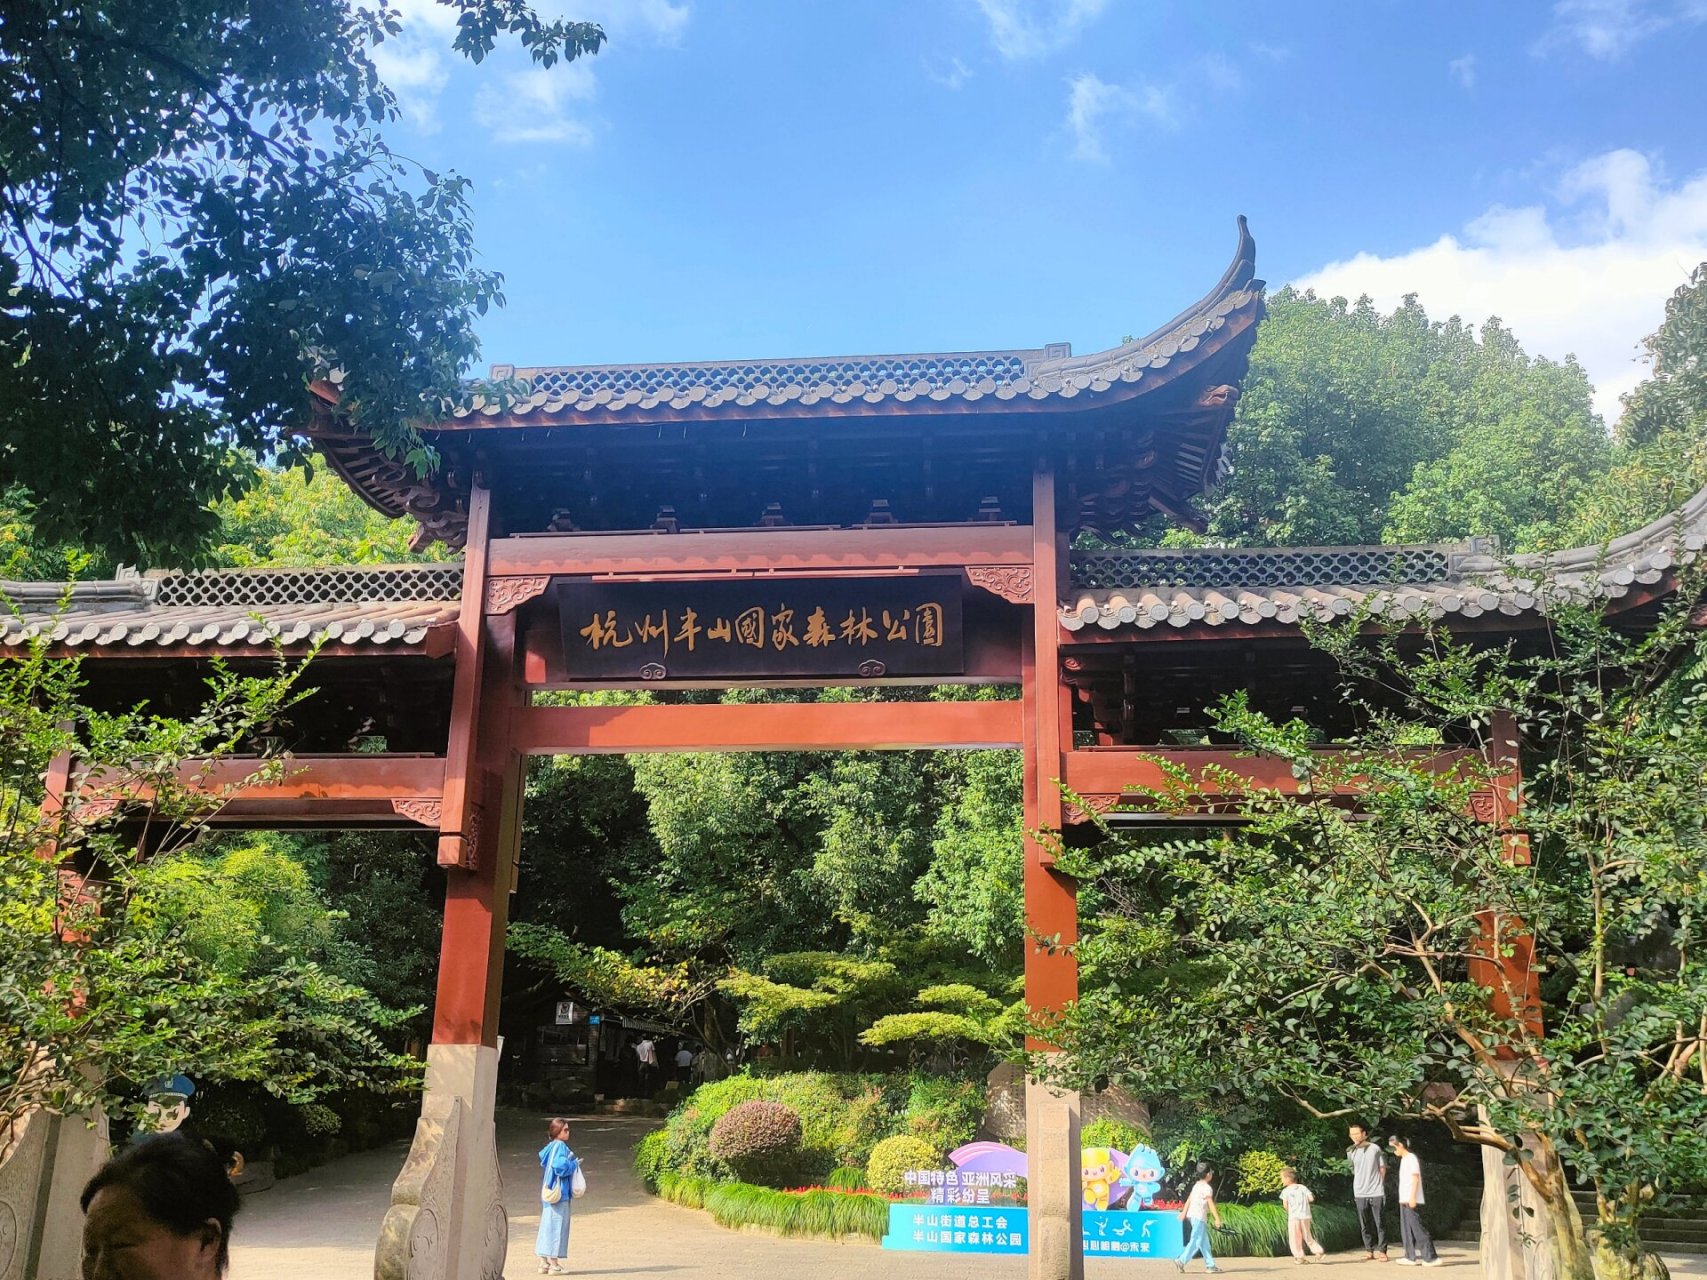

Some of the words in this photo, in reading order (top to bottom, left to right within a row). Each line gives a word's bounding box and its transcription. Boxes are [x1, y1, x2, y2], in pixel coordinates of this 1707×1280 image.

[580, 602, 943, 658] 杭州半山國家森林公園
[904, 1170, 958, 1186] 中国特色
[962, 1171, 1017, 1188] 亚洲风采
[930, 1187, 990, 1204] 精彩纷呈
[913, 1213, 1008, 1229] 半山街道总工会
[913, 1230, 1022, 1246] 半山国家森林公园
